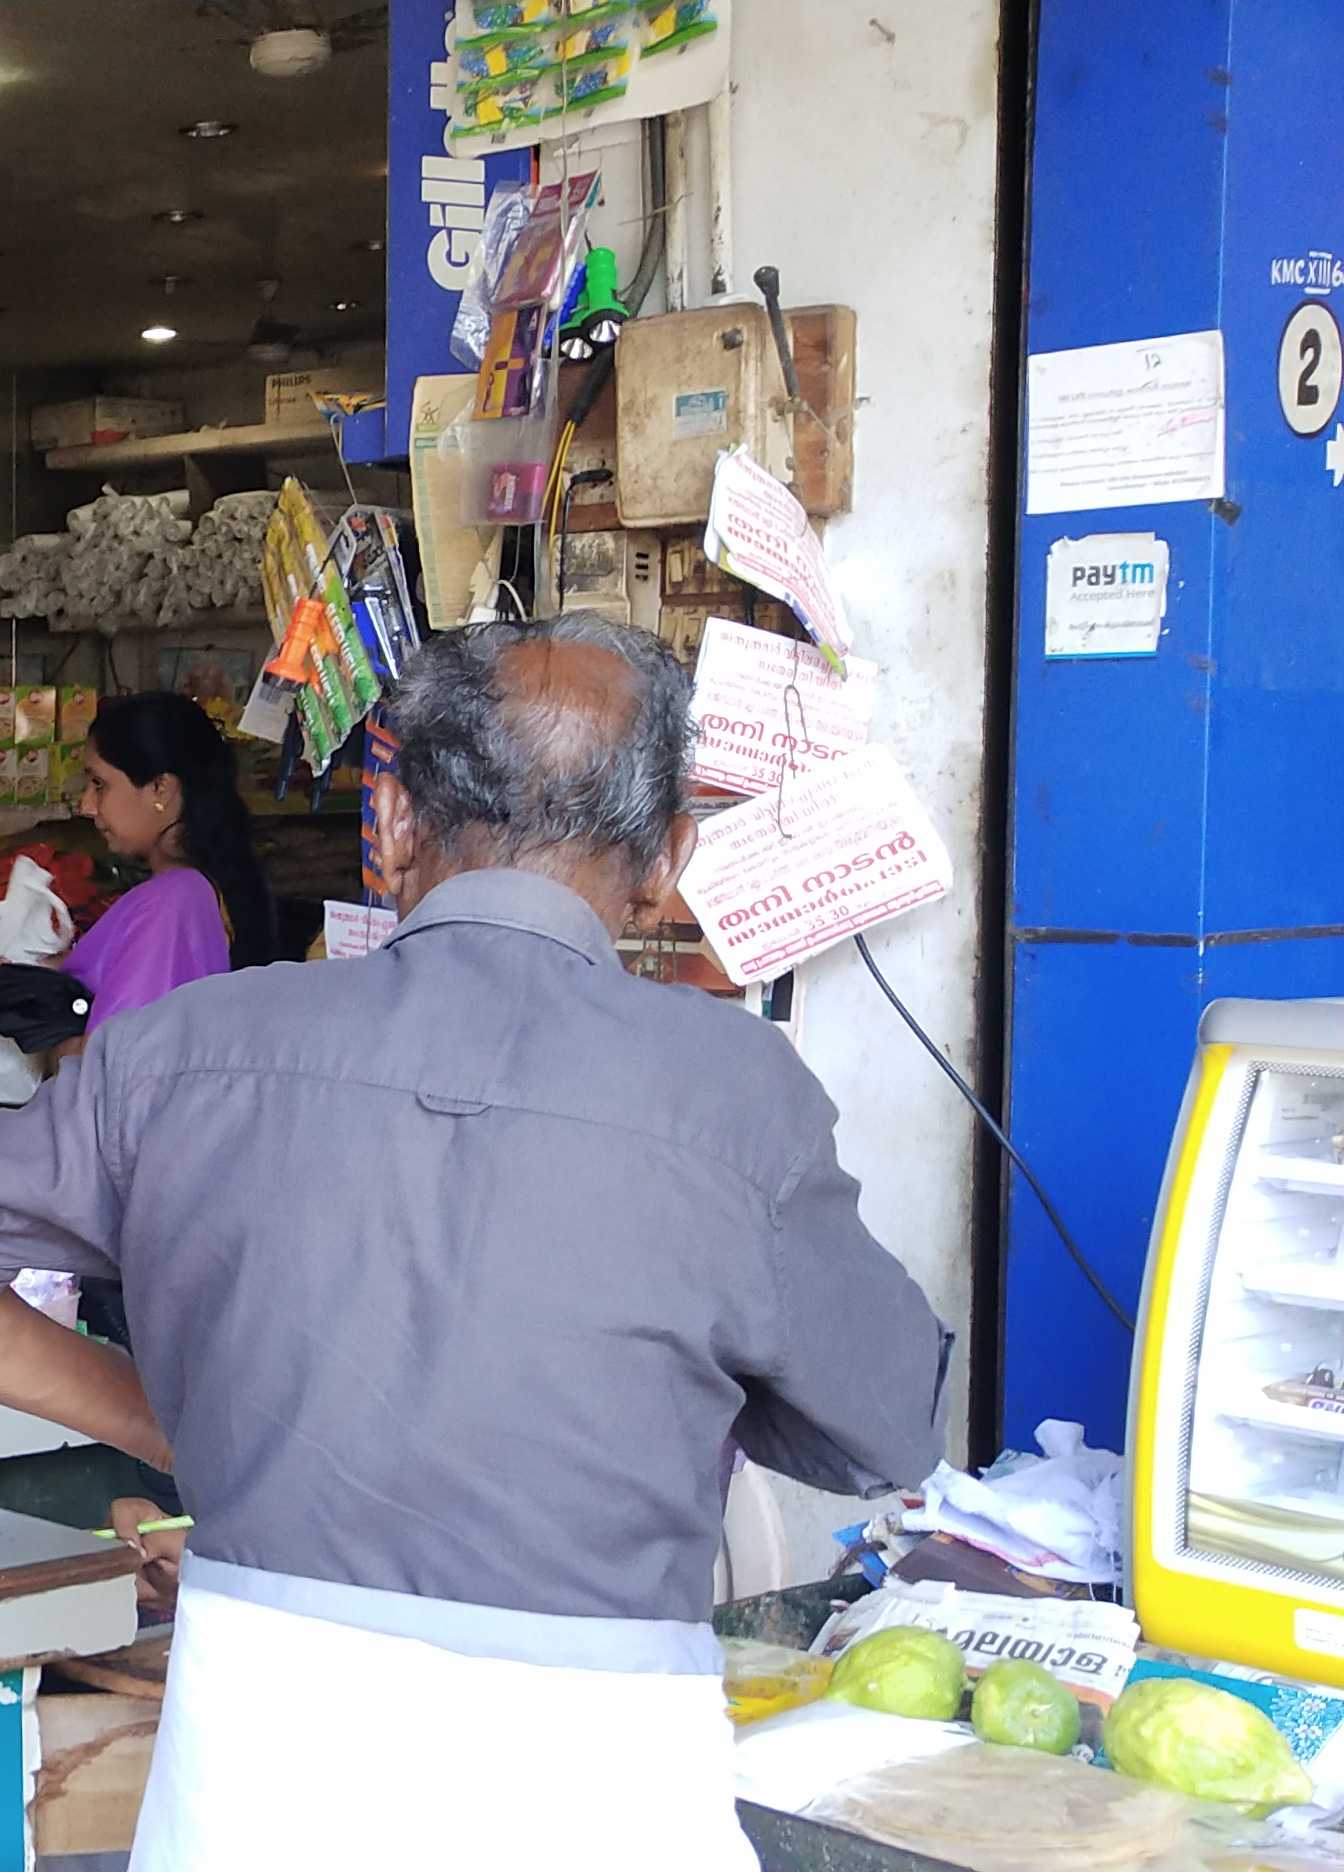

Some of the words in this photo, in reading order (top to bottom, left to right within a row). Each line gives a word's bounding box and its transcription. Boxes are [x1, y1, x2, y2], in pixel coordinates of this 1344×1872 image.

[1271, 258, 1305, 286] KMC
[1297, 328, 1322, 406] 2
[1070, 590, 1123, 603] Accepted
[1126, 589, 1155, 599] Here
[700, 713, 765, 742] തനി
[717, 884, 794, 932] തനി
[831, 904, 850, 921] 30
